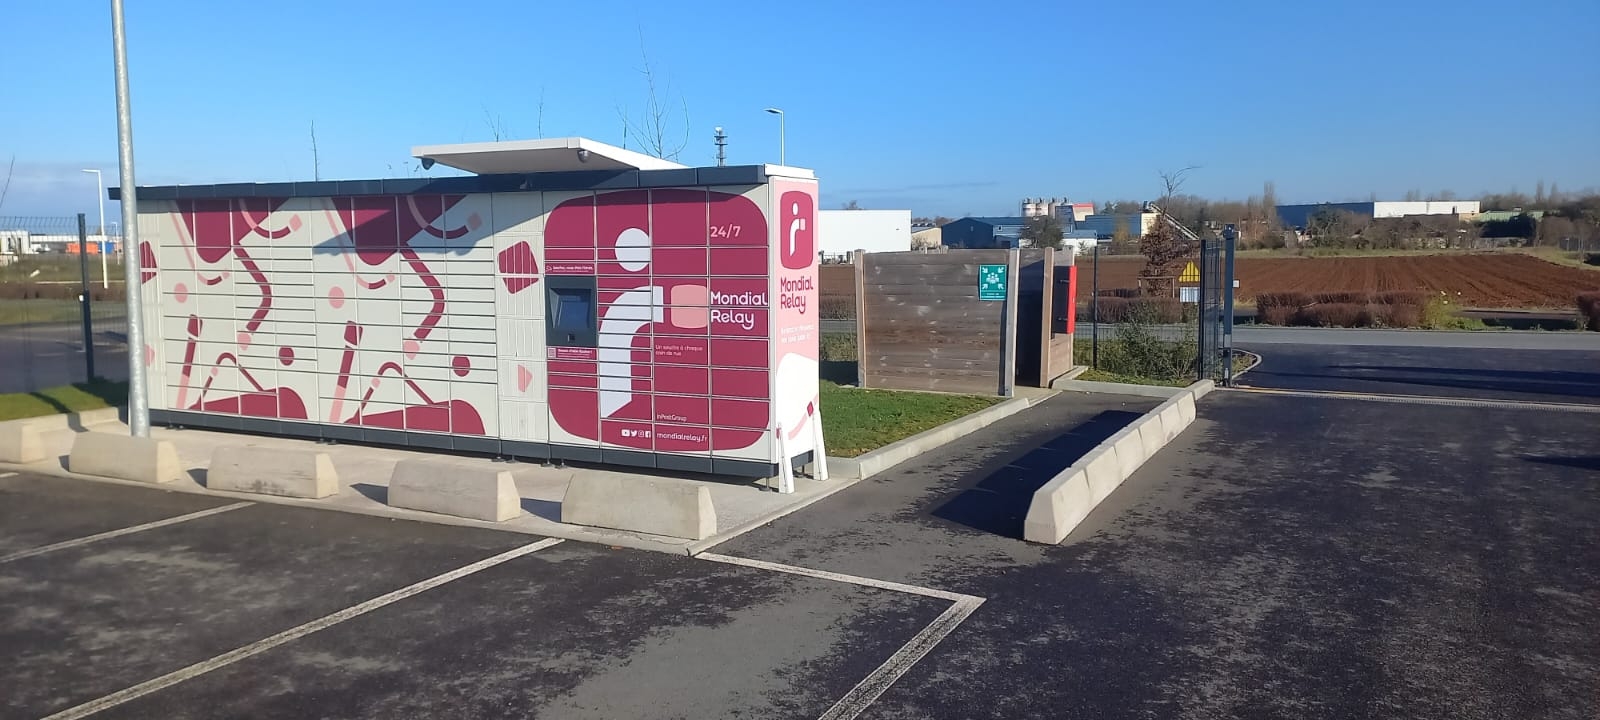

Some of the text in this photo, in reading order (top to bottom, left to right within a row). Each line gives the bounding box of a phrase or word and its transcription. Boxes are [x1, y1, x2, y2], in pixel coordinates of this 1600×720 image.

[710, 224, 741, 238] 24/7
[780, 276, 814, 293] Mondial
[710, 291, 768, 305] Mondial
[780, 293, 806, 314] Relay
[710, 309, 754, 330] Relay
[656, 432, 707, 443] mondialrelay.fr
